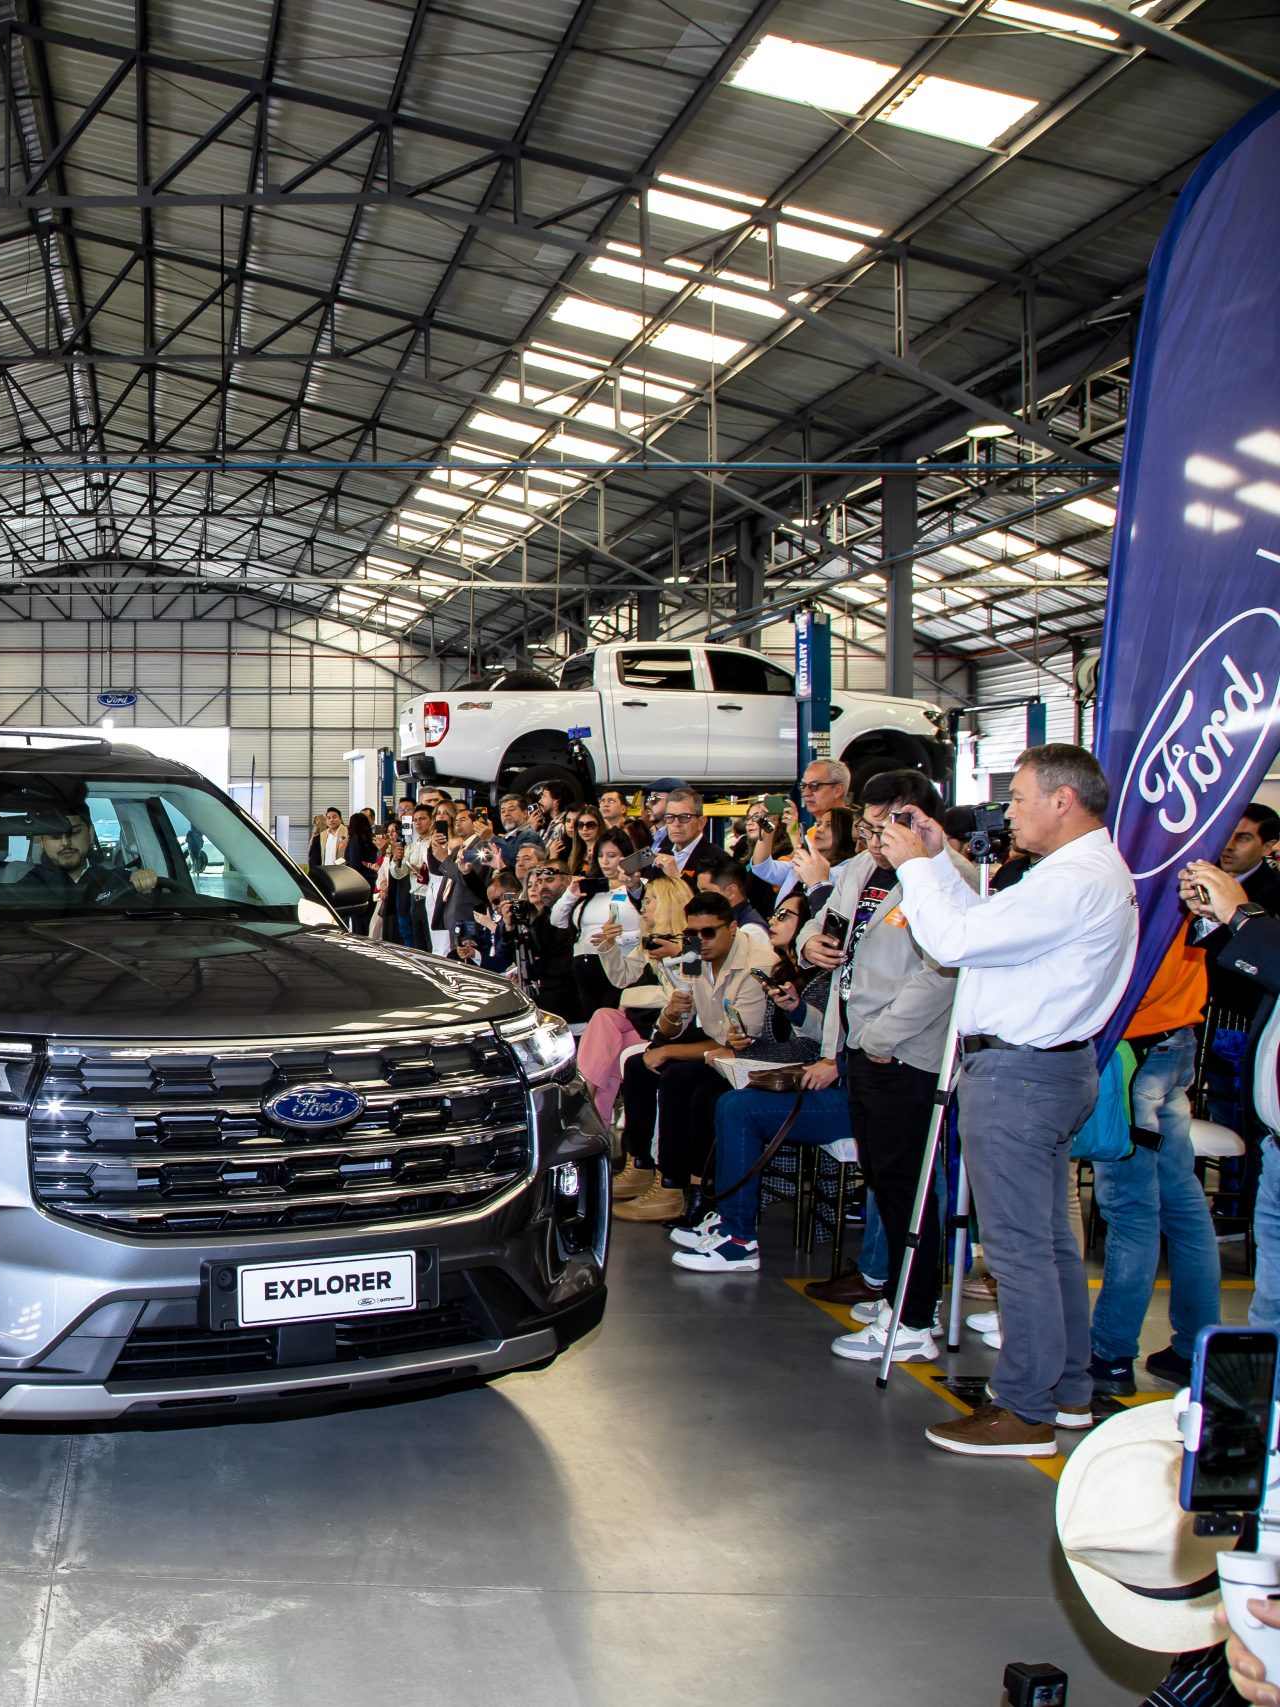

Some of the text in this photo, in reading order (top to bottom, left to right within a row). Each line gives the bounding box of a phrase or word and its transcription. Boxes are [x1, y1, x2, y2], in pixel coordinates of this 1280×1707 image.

[799, 643, 808, 690] ROTARY
[1138, 654, 1264, 833] Ford
[292, 1092, 344, 1117] Ford
[264, 1270, 392, 1301] EXPLORER
